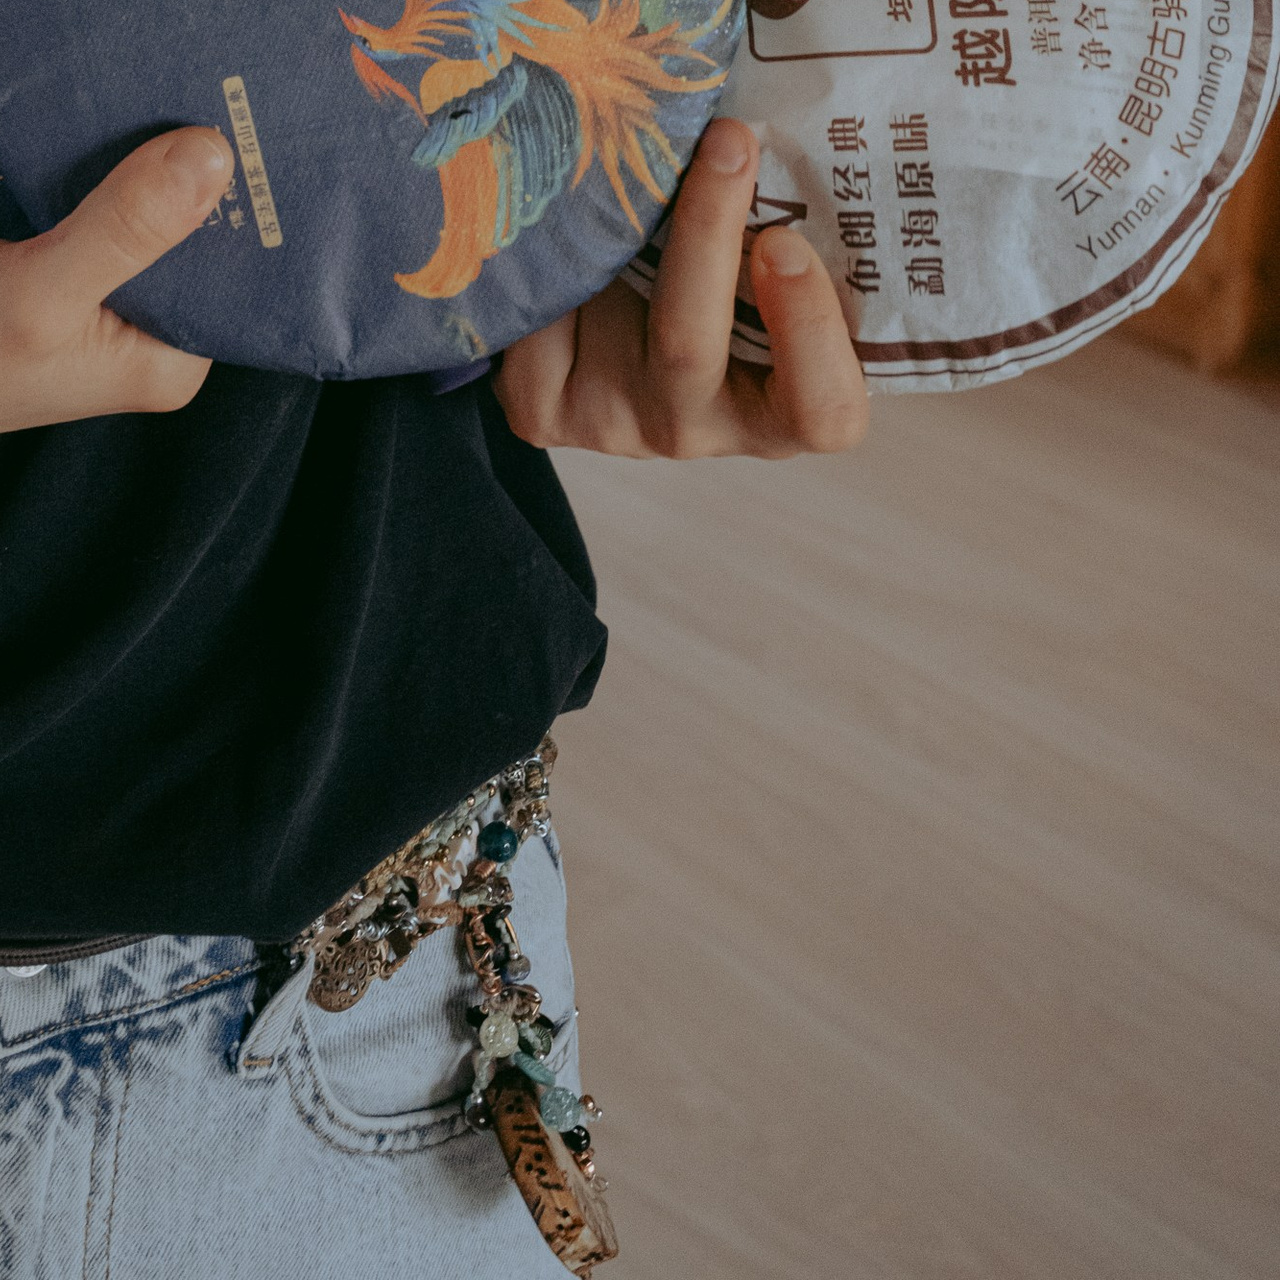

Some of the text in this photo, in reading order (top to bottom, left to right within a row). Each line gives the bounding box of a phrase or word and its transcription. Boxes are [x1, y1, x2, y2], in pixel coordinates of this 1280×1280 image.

[826, 115, 880, 297] 布朗经典
[888, 113, 949, 298] 勐海原味
[1077, 184, 1166, 260] Yunnan
[1171, 44, 1231, 158] Kunming
